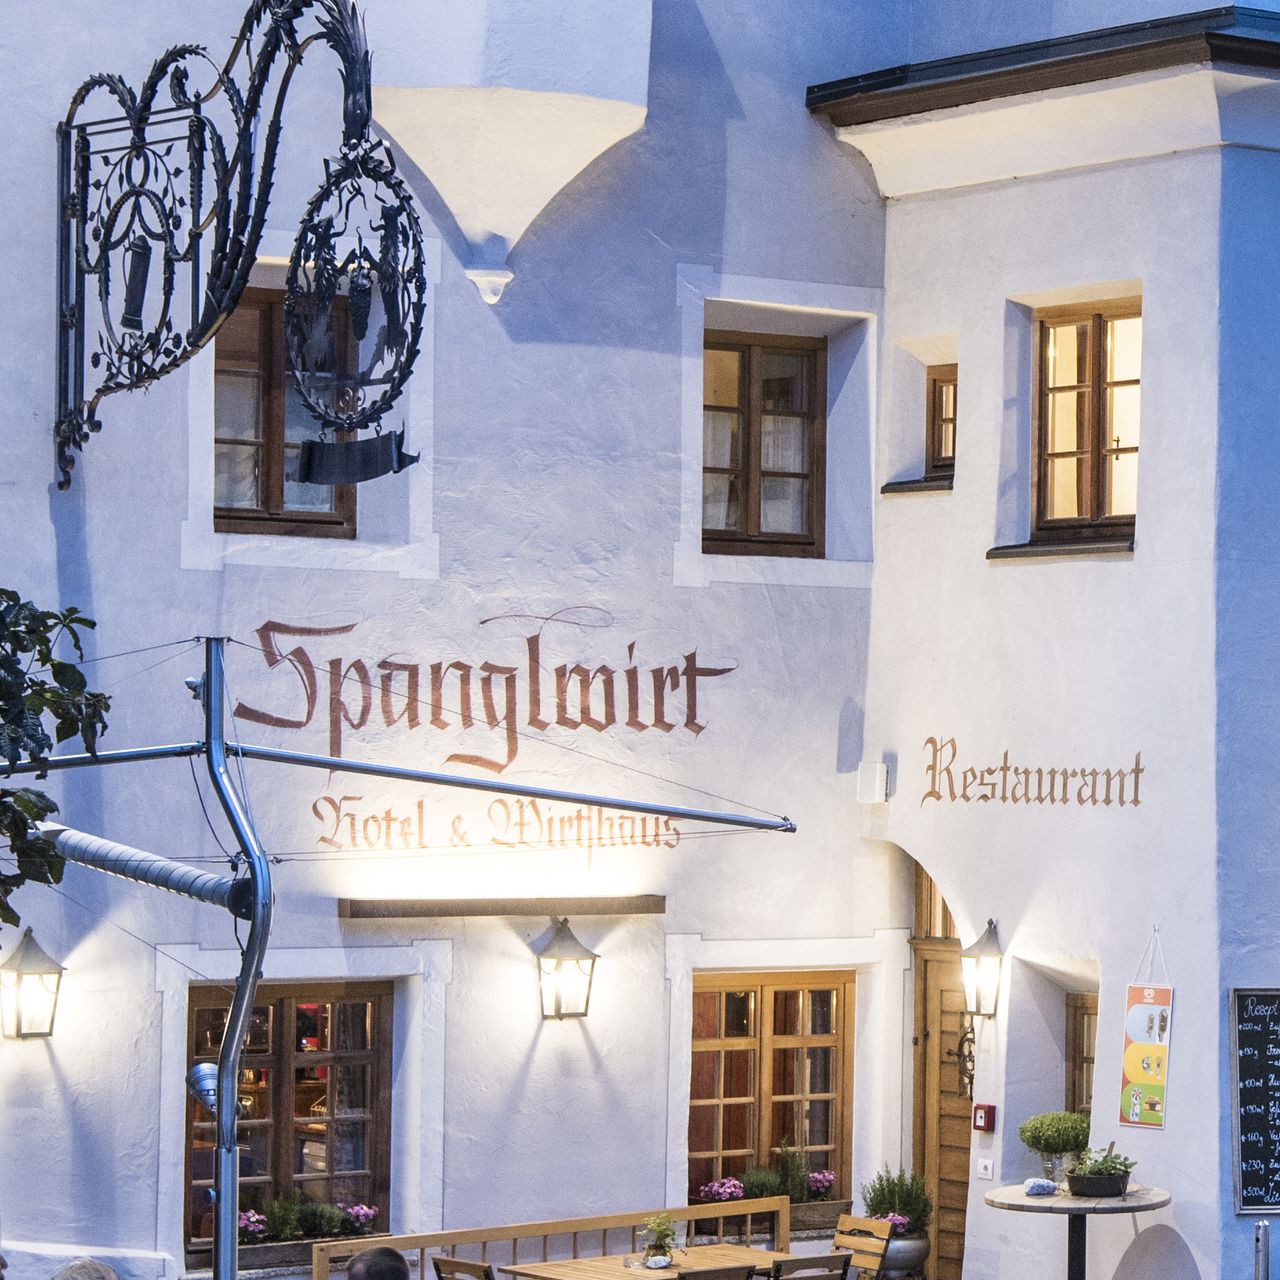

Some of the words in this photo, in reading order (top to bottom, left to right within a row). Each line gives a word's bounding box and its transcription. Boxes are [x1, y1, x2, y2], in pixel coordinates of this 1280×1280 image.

[234, 608, 739, 783] Spanglwirt
[920, 736, 1147, 808] Restaurant
[312, 795, 429, 850] Hotel
[450, 813, 473, 848] &
